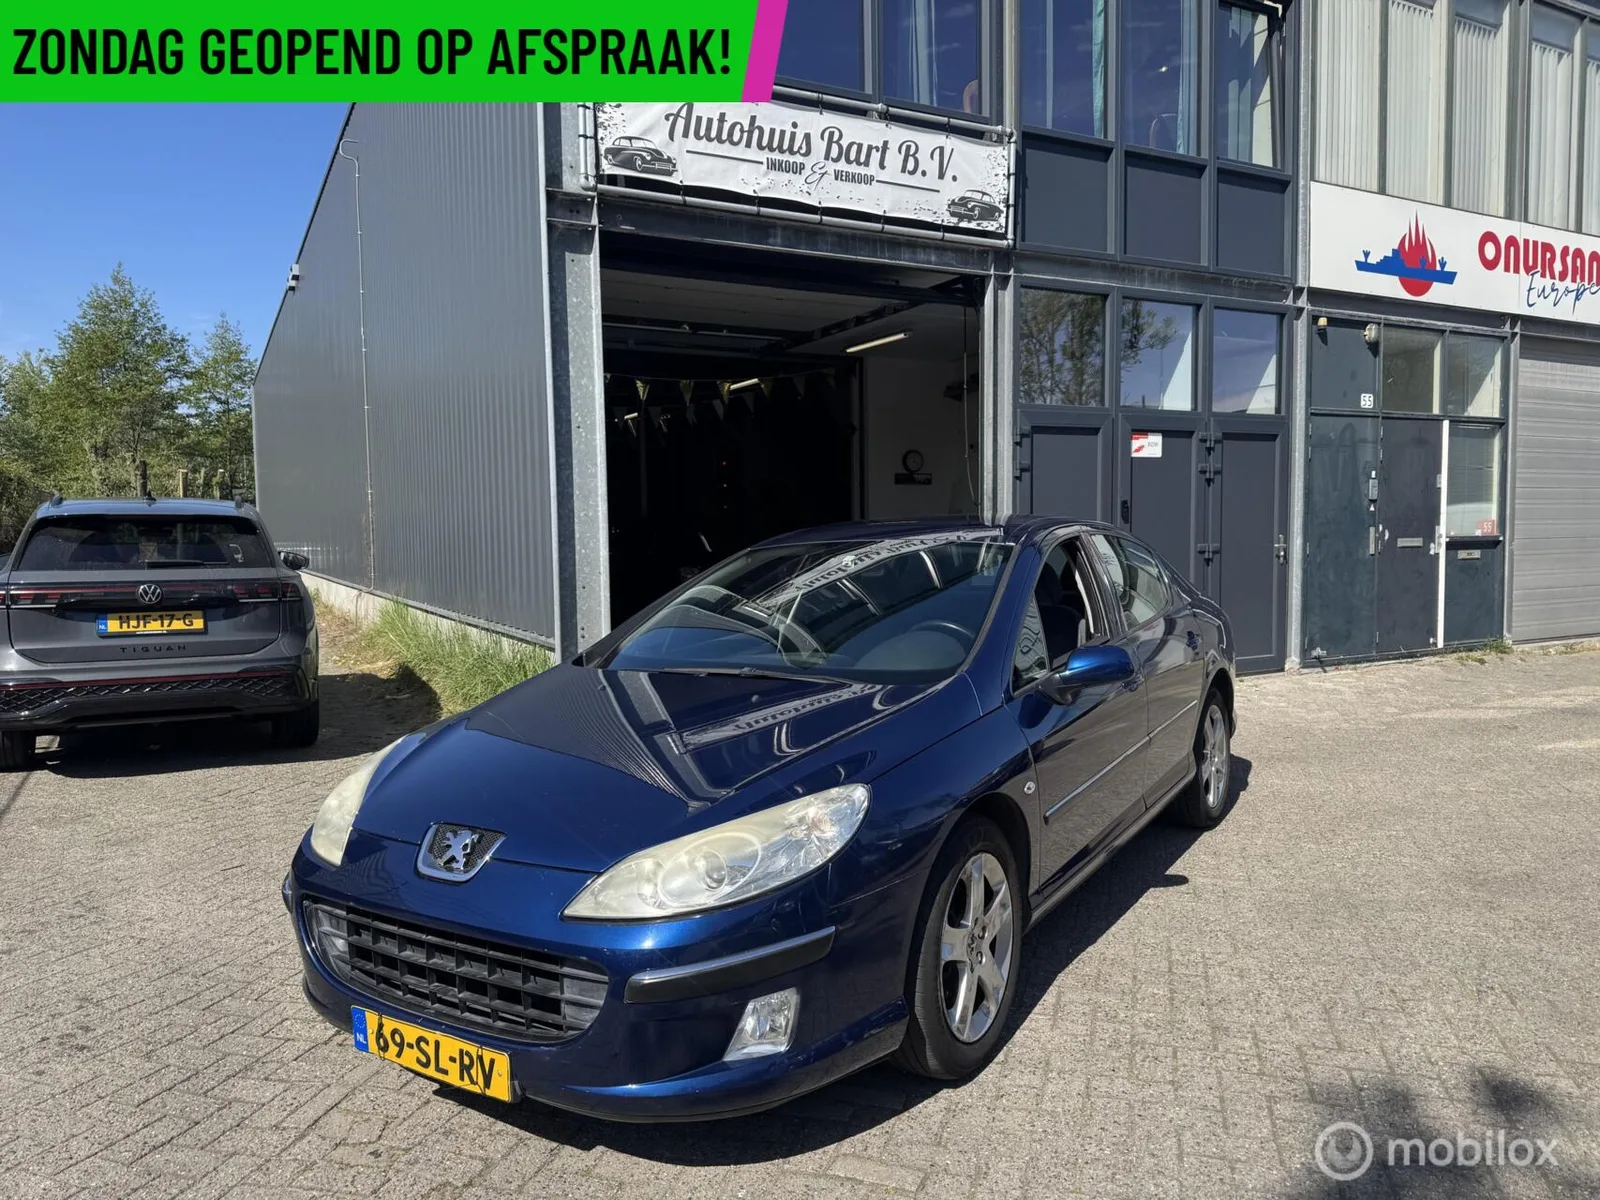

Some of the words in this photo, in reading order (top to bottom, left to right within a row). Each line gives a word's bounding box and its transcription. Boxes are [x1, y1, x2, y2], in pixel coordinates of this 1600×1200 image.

[664, 101, 812, 157] Autohuis
[820, 126, 890, 170] Bart
[898, 140, 957, 182] B.V.
[766, 157, 805, 175] INKOOP
[833, 169, 875, 186] VERKOOP
[1527, 270, 1600, 315] Europe
[119, 613, 194, 629] HJF-17-G
[120, 645, 186, 653] TIGUAN
[356, 1033, 367, 1044] NL
[375, 1022, 495, 1090] 69-SL-RV
